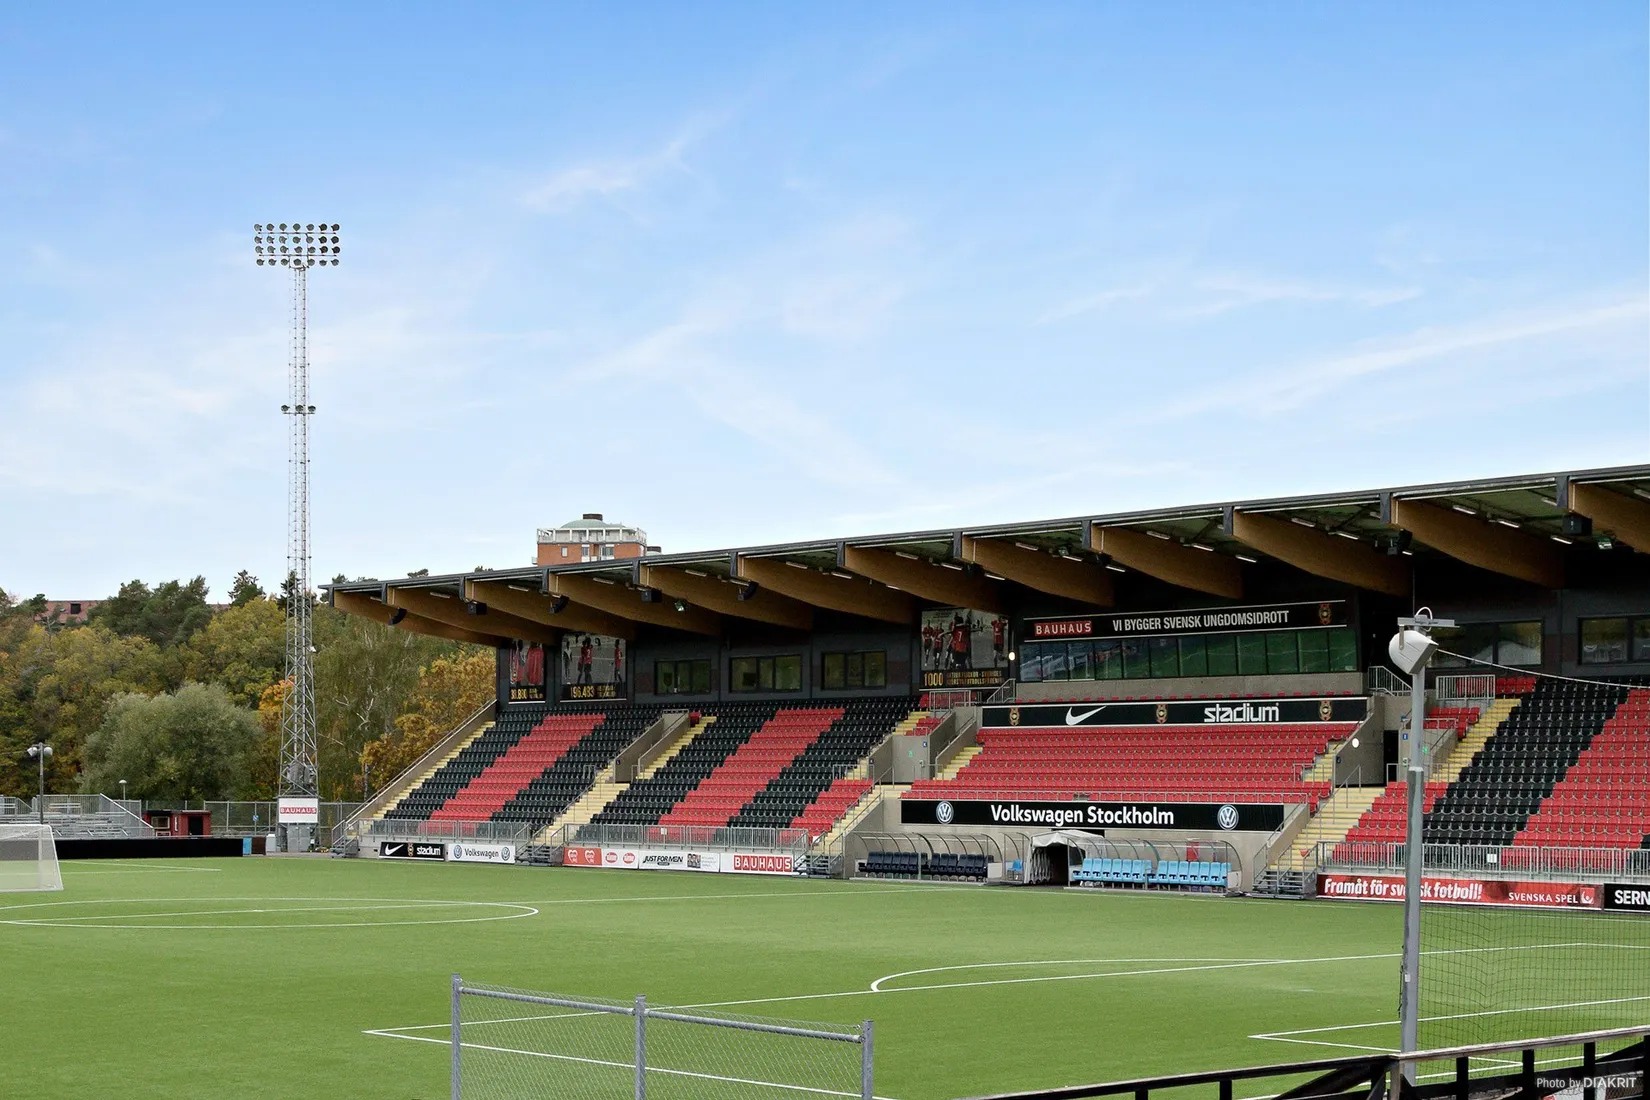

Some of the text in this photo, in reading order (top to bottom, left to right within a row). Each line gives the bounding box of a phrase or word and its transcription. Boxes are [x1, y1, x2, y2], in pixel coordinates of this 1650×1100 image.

[1035, 620, 1092, 635] BAUHAUS
[1112, 610, 1290, 632] VI BYGGER SVENSK UNGDOMSIDROTT
[923, 672, 944, 687] 1000
[1203, 703, 1280, 723] stadium
[280, 806, 317, 815] BAUHAUS
[991, 804, 1175, 827] Volkswagen Stockholm
[416, 846, 441, 857] stadium
[464, 848, 500, 860] Volkswagen
[643, 855, 657, 863] JUST
[669, 855, 684, 863] MEN
[734, 855, 792, 872] BAUHAUS
[1324, 878, 1368, 895] Framåt
[1370, 880, 1388, 896] för
[1433, 882, 1483, 900] fotboll!
[1508, 892, 1579, 904] SVENSKA SPEL
